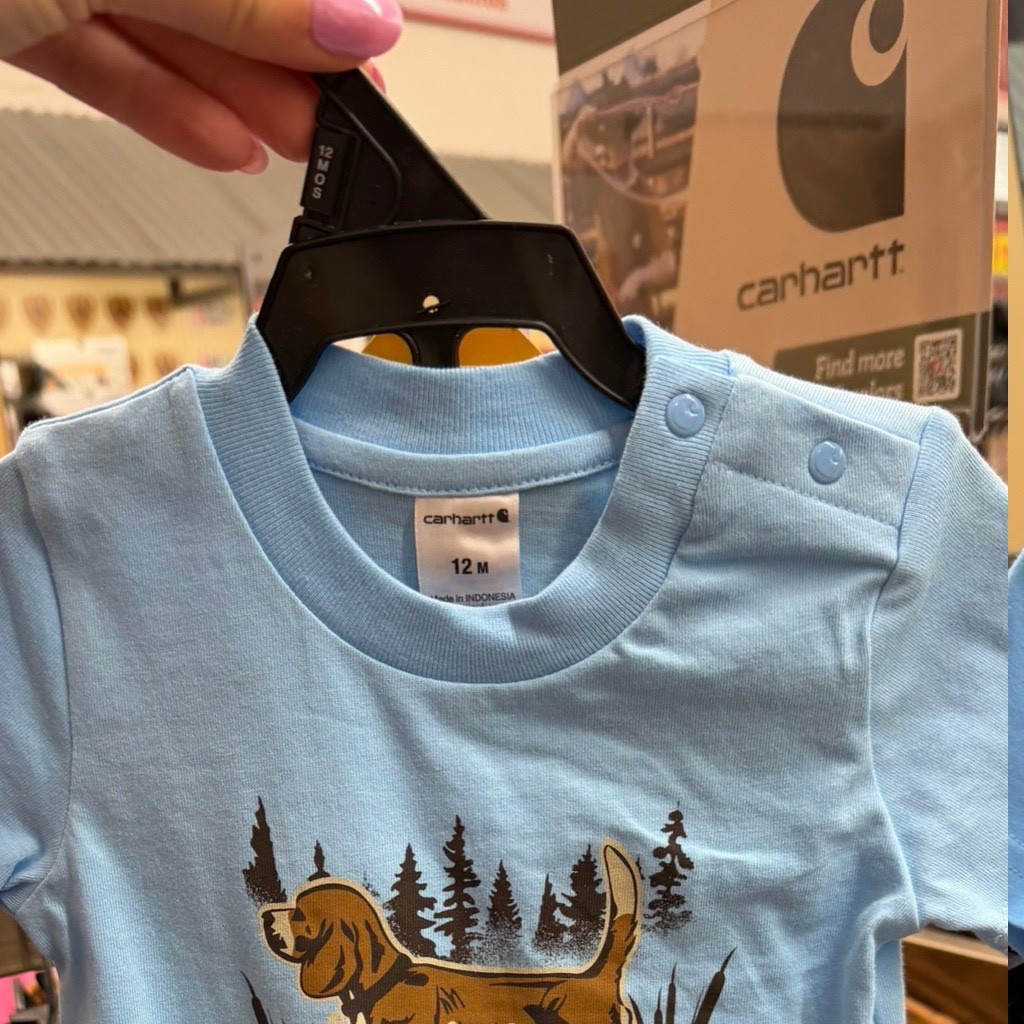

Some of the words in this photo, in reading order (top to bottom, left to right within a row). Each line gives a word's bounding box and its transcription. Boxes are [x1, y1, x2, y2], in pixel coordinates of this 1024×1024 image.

[319, 145, 334, 159] 12
[737, 239, 905, 311] carhartt
[815, 347, 856, 380] Find
[858, 348, 905, 374] more
[423, 514, 495, 525] carhartt
[452, 558, 473, 575] 12
[477, 562, 489, 574] M
[456, 594, 464, 602] in
[465, 592, 516, 602] INDONESIA
